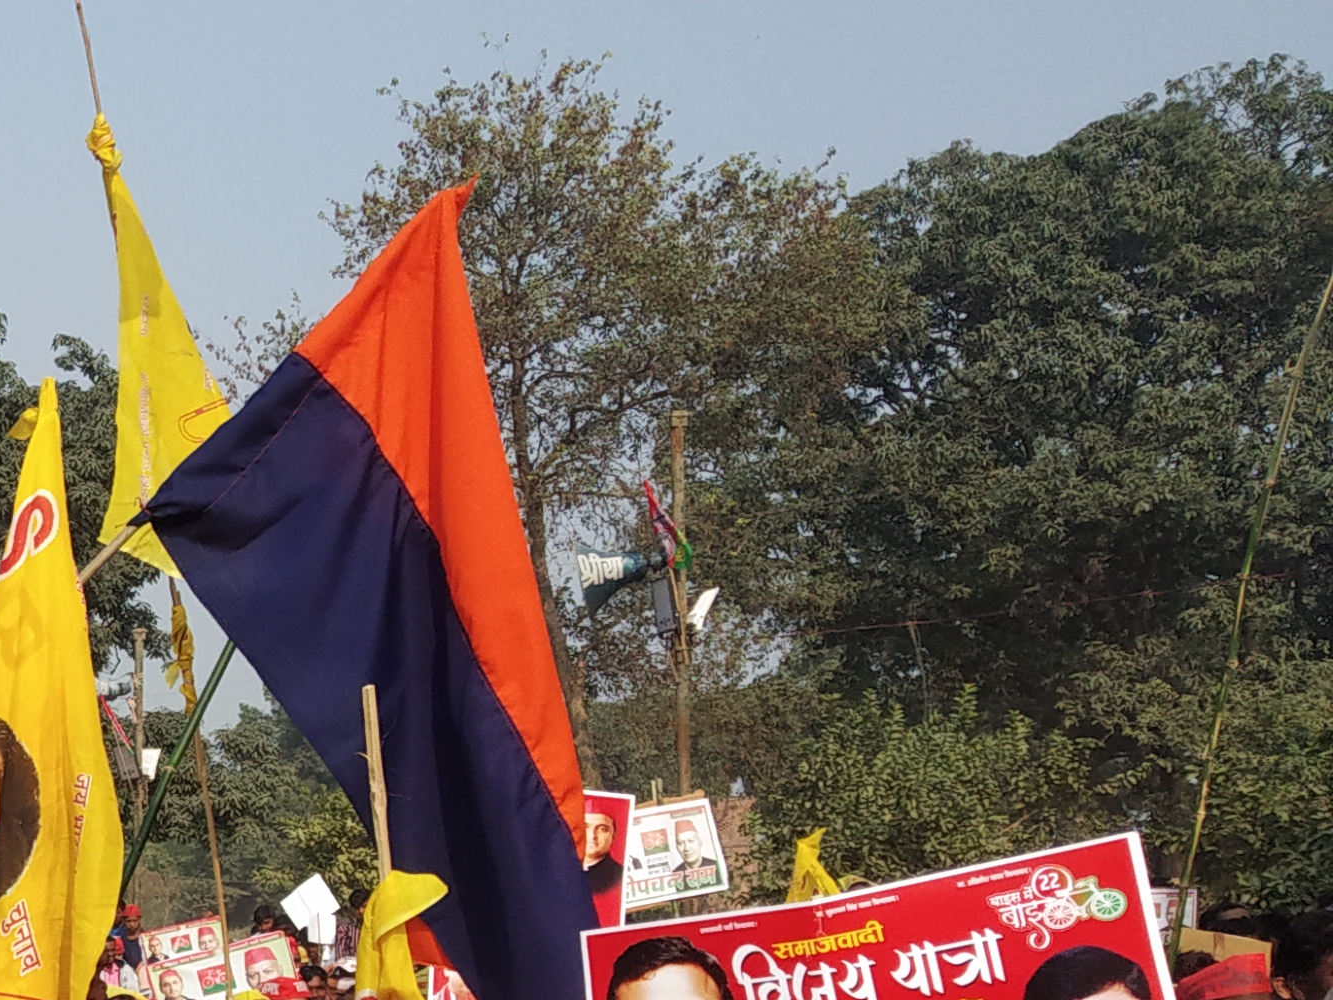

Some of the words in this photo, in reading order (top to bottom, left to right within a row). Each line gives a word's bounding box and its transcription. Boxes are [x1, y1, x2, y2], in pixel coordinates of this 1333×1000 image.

[1037, 872, 1061, 892] 22
[0, 899, 43, 977] चुनाव
[772, 919, 885, 960] समाजवादी
[890, 927, 1007, 997] यात्रा
